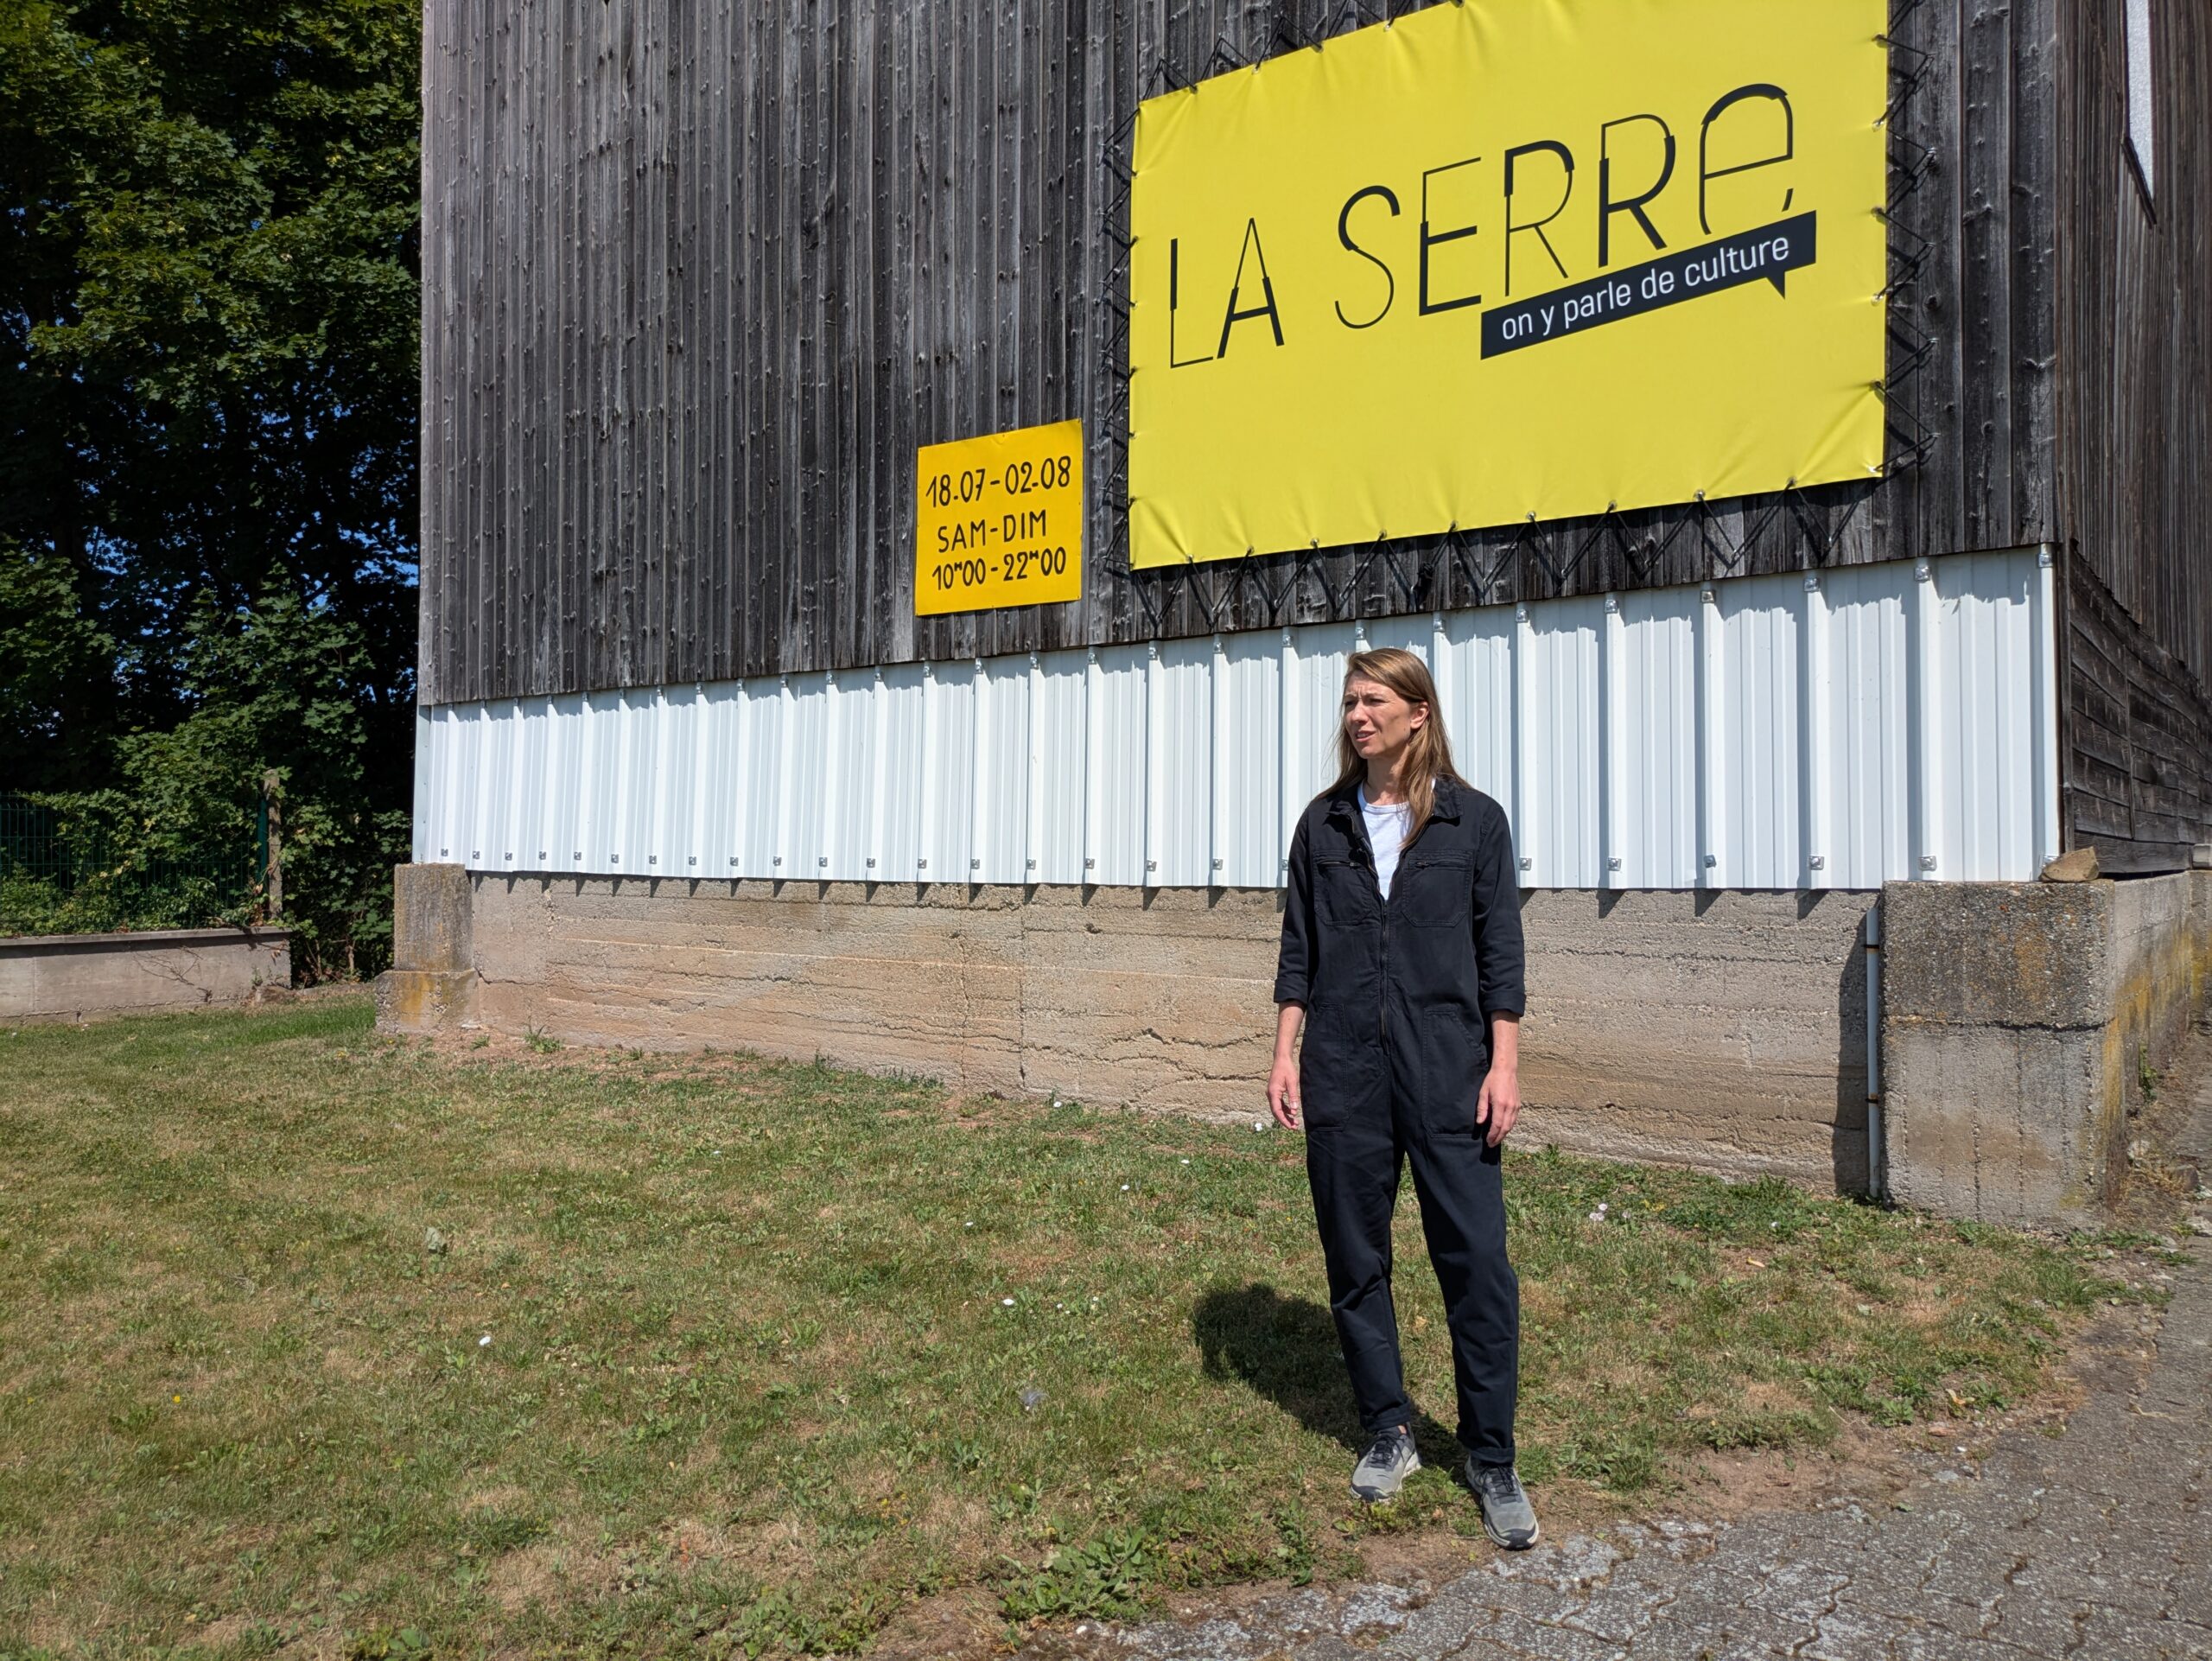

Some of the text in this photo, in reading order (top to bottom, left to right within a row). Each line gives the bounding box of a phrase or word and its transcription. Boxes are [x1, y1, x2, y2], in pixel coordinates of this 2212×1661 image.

[1170, 218, 1284, 368] LA
[1502, 236, 1790, 340] on y parle de culture
